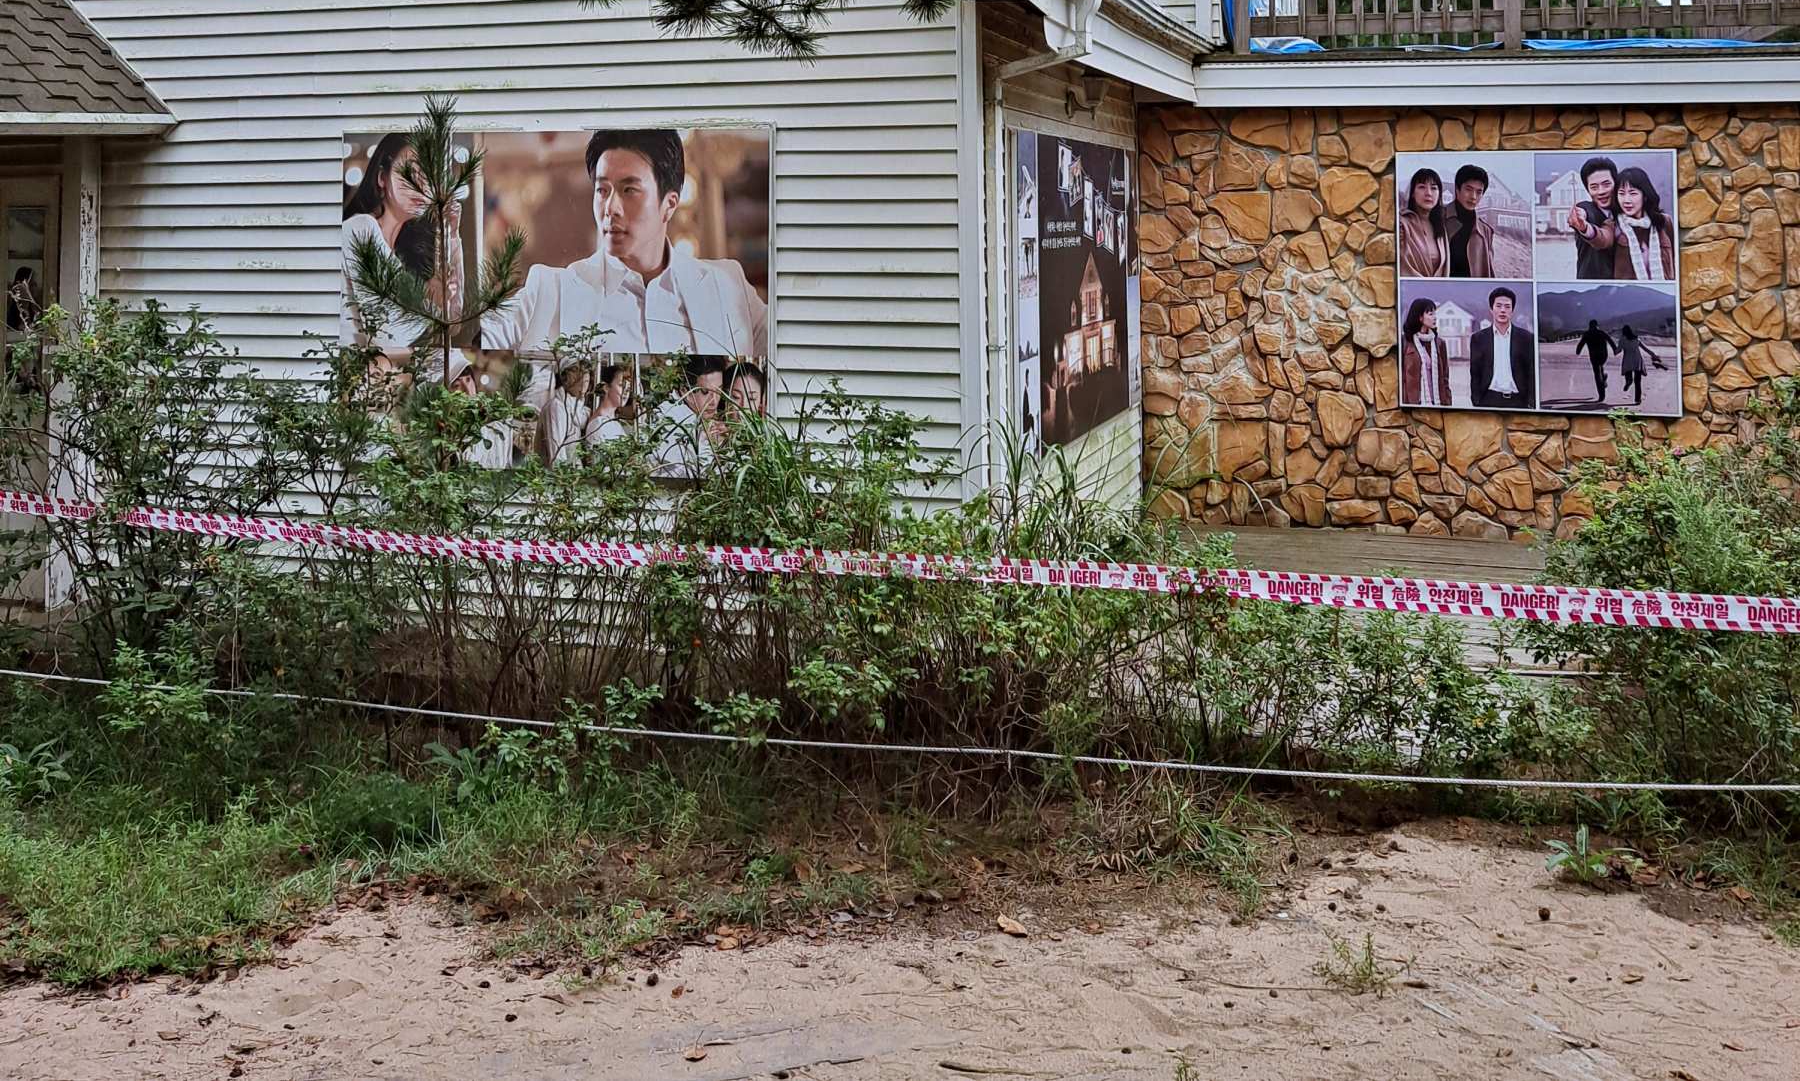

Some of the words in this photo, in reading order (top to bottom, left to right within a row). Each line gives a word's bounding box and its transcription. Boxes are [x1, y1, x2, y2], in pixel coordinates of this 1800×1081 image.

[587, 548, 632, 559] 안전제일
[721, 553, 743, 566] 위험
[1132, 572, 1157, 587] 위험
[1268, 580, 1323, 597] DANGER!
[1357, 584, 1383, 599] 위험
[1391, 587, 1420, 602] 危險
[1428, 588, 1483, 605] 안전제일
[1501, 592, 1560, 609] DANGER!
[1594, 596, 1622, 613] 위험
[1632, 599, 1662, 616] 危險
[1671, 601, 1729, 620] 안전제일
